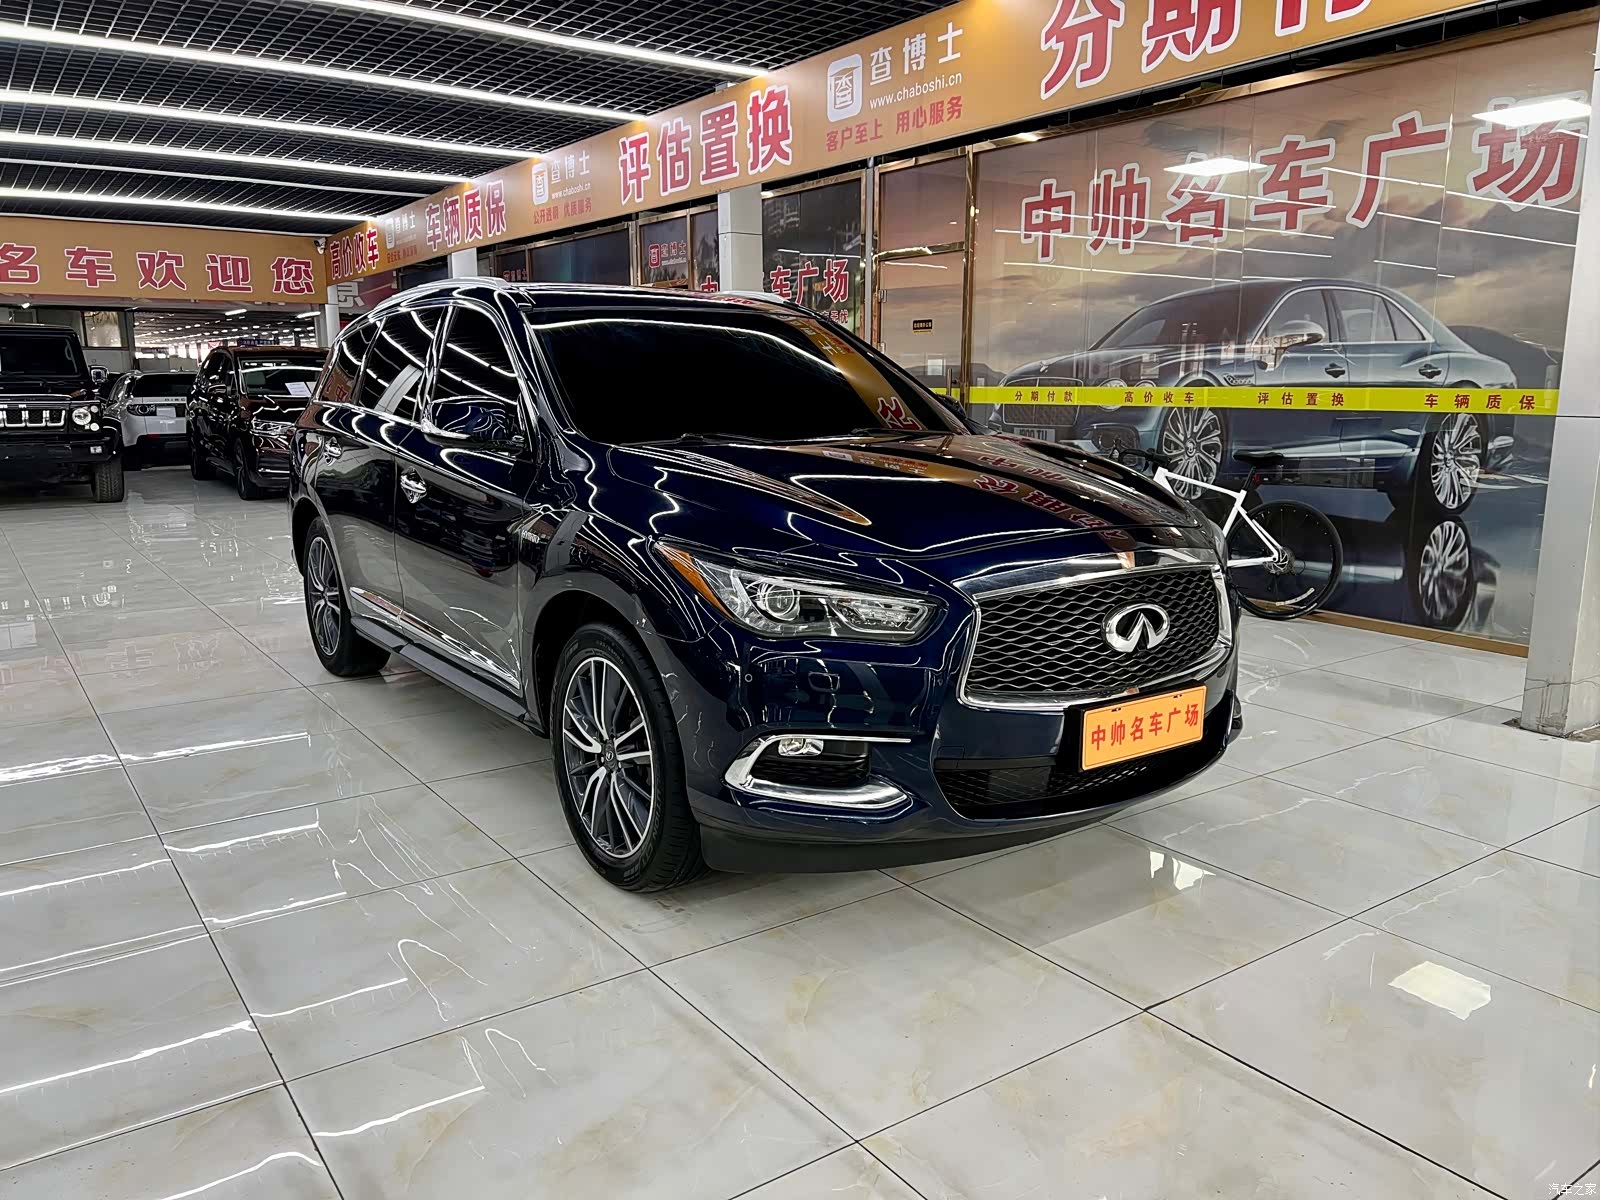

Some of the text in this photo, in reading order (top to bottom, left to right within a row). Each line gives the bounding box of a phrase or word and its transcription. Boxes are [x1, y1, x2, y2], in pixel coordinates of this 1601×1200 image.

[869, 22, 963, 85] 查博士
[869, 72, 962, 109] www.chaboshi.cn
[619, 84, 793, 206] 评估置换
[826, 96, 963, 152] 客户至上 用心服务
[1021, 90, 1588, 263] 中帅名车广场
[425, 180, 507, 251] 车辆质保
[0, 243, 315, 295] 名车欢迎您
[330, 227, 380, 280] 高价收车
[770, 259, 849, 304] 车广场
[1014, 391, 1536, 410] 分期付款 高价收车 评估置换 车辆质保
[1091, 704, 1199, 750] 中帅名车广场
